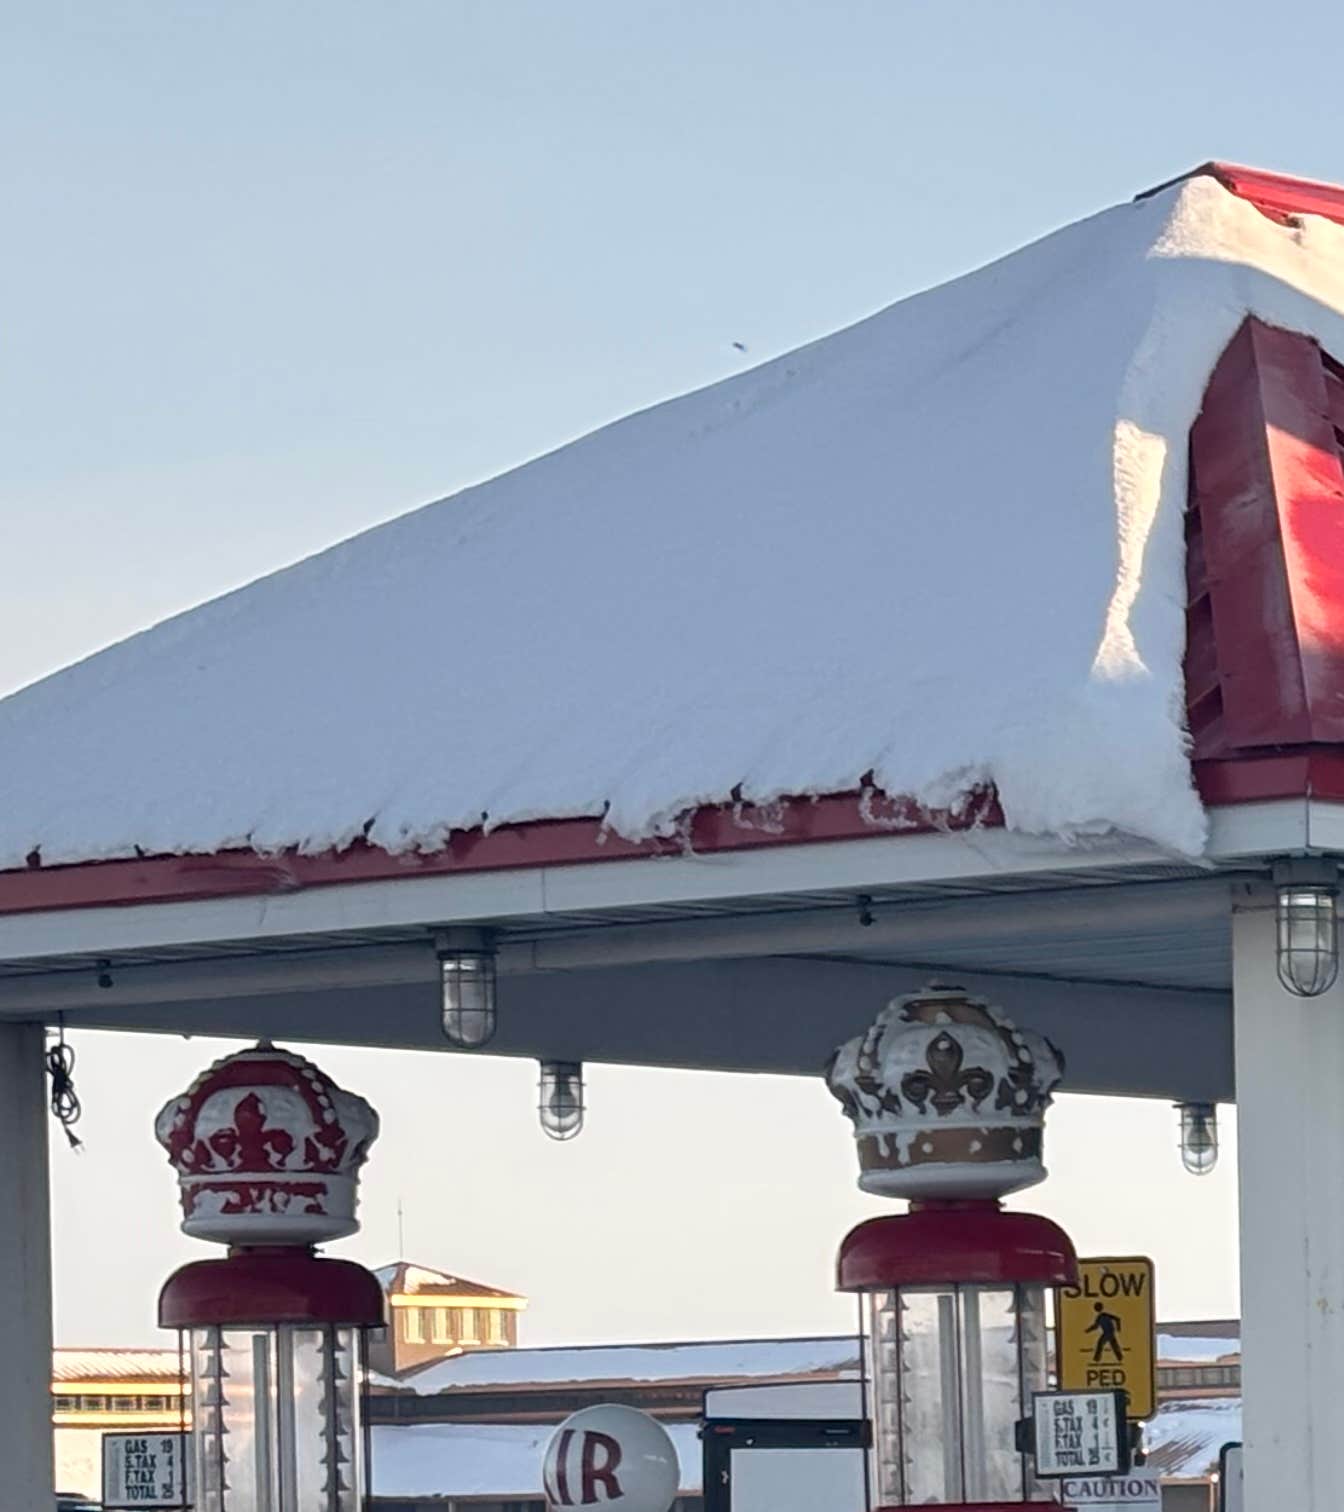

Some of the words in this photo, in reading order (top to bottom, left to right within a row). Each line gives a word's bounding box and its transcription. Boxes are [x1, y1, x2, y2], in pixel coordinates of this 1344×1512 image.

[1086, 1369, 1127, 1387] PED
[1054, 1399, 1074, 1416] GAS
[125, 1439, 148, 1454] GAS
[544, 1428, 625, 1506] IR
[1056, 1450, 1086, 1467] TOTAL
[125, 1485, 158, 1500] TOTAL
[1064, 1479, 1159, 1499] CAUTION
